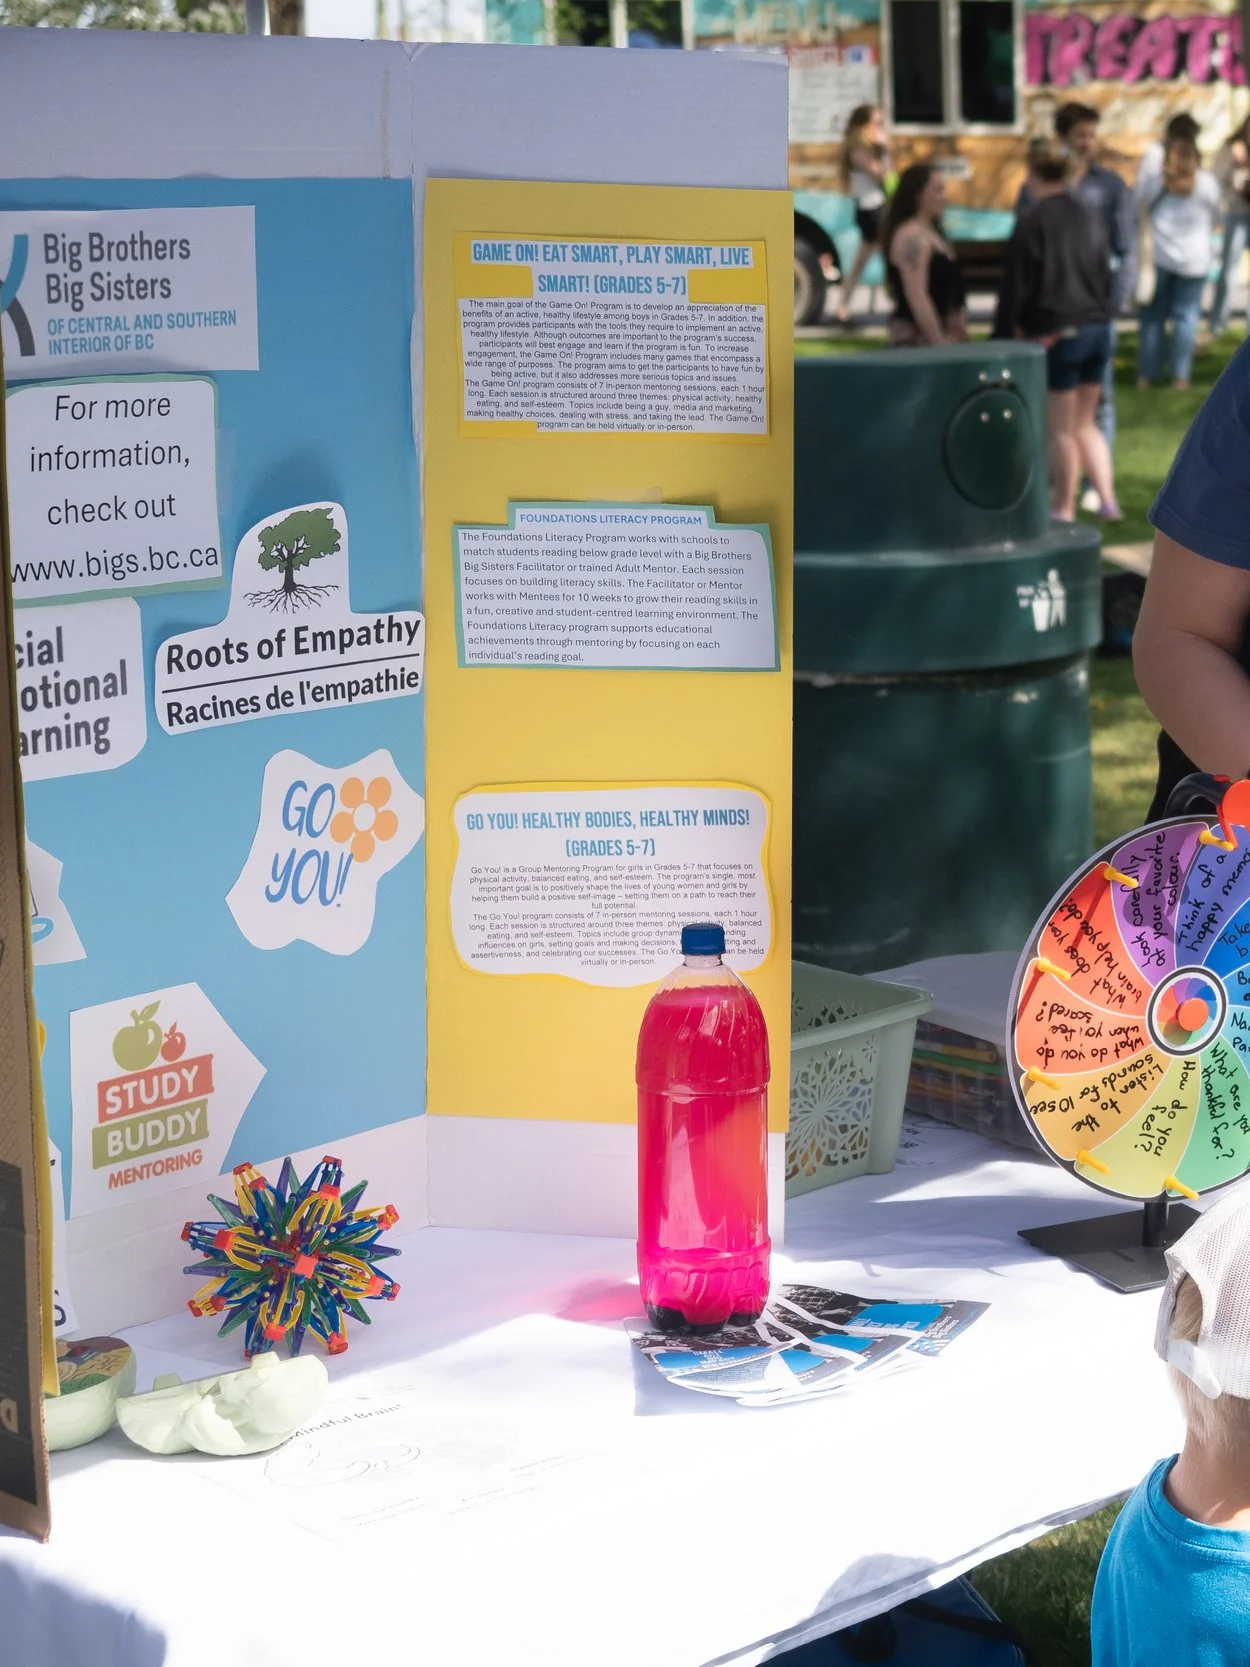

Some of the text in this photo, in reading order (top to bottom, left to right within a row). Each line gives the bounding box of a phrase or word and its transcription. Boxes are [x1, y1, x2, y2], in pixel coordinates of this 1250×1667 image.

[44, 230, 191, 273] Big Brothers
[473, 242, 750, 267] GAME ON! EAT SMART, PLAY SMART, LIVE
[46, 271, 172, 312] Big Sisters
[537, 273, 687, 295] SMART! (GRADES 5-7)
[468, 299, 484, 310] The
[485, 299, 504, 310] main
[506, 300, 523, 309] goal
[524, 300, 533, 311] of
[534, 300, 547, 308] the
[547, 300, 572, 309] Game
[573, 301, 588, 312] On!
[589, 301, 623, 313] Program
[624, 302, 631, 310] is
[633, 301, 641, 310] to
[642, 302, 673, 313] develop
[686, 302, 733, 314] appreciation
[734, 303, 743, 312] of
[744, 303, 757, 312] the
[47, 310, 237, 336] OF CENTRAL AND SOUTHERN
[48, 333, 154, 355] INTERIOR OF BC
[55, 395, 171, 421] For more
[537, 421, 569, 431] program
[586, 420, 596, 429] be
[597, 421, 614, 429] held
[615, 420, 645, 431] virtually
[646, 421, 655, 430] or
[656, 421, 694, 433] in-person.
[30, 440, 190, 472] information,
[48, 494, 177, 525] check out
[519, 513, 701, 525] FOUNDATIONS LITERACY PROGRAM
[461, 531, 729, 544] The Foundations Literacy Program works with schools to
[12, 546, 219, 583] www.bigs.bc.ca
[463, 546, 494, 556] match
[496, 546, 539, 556] students
[541, 547, 577, 558] reading
[579, 547, 608, 557] below
[610, 548, 637, 559] grade
[639, 548, 662, 558] level
[663, 548, 684, 558] with
[694, 549, 709, 561] Big
[711, 550, 751, 560] Brothers
[166, 615, 421, 674] Roots of Empathy
[167, 667, 420, 727] Racines de l'empathie
[282, 780, 336, 838] GO
[466, 808, 750, 830] GO YOU! HEALTHY BODIES, HEALTHY MINDS!
[565, 837, 655, 857] (GRADES 5-7)
[264, 847, 354, 907] YOU!
[591, 900, 636, 910] full potential.
[1178, 854, 1227, 944] Think of a
[1080, 920, 1103, 944] you
[1153, 905, 1168, 940] your
[1186, 902, 1223, 951] happy
[579, 957, 608, 967] virtually
[619, 957, 656, 967] in-person.
[1064, 946, 1090, 977] does
[1094, 942, 1118, 977] help
[1131, 931, 1150, 968] Look
[1109, 1025, 1139, 1039] when
[1036, 1047, 1055, 1069] do
[1091, 1048, 1108, 1063] do
[1102, 1053, 1154, 1092] sounds
[105, 1064, 199, 1115] STUDY
[1059, 1096, 1075, 1112] 10
[1071, 1063, 1164, 1132] Listen to the
[1079, 1085, 1101, 1103] for
[1201, 1064, 1226, 1120] thankful
[1210, 1042, 1250, 1135] What are you
[1153, 1060, 1196, 1157] How do you
[107, 1107, 201, 1158] BUDDY
[108, 1148, 203, 1190] MENTORING
